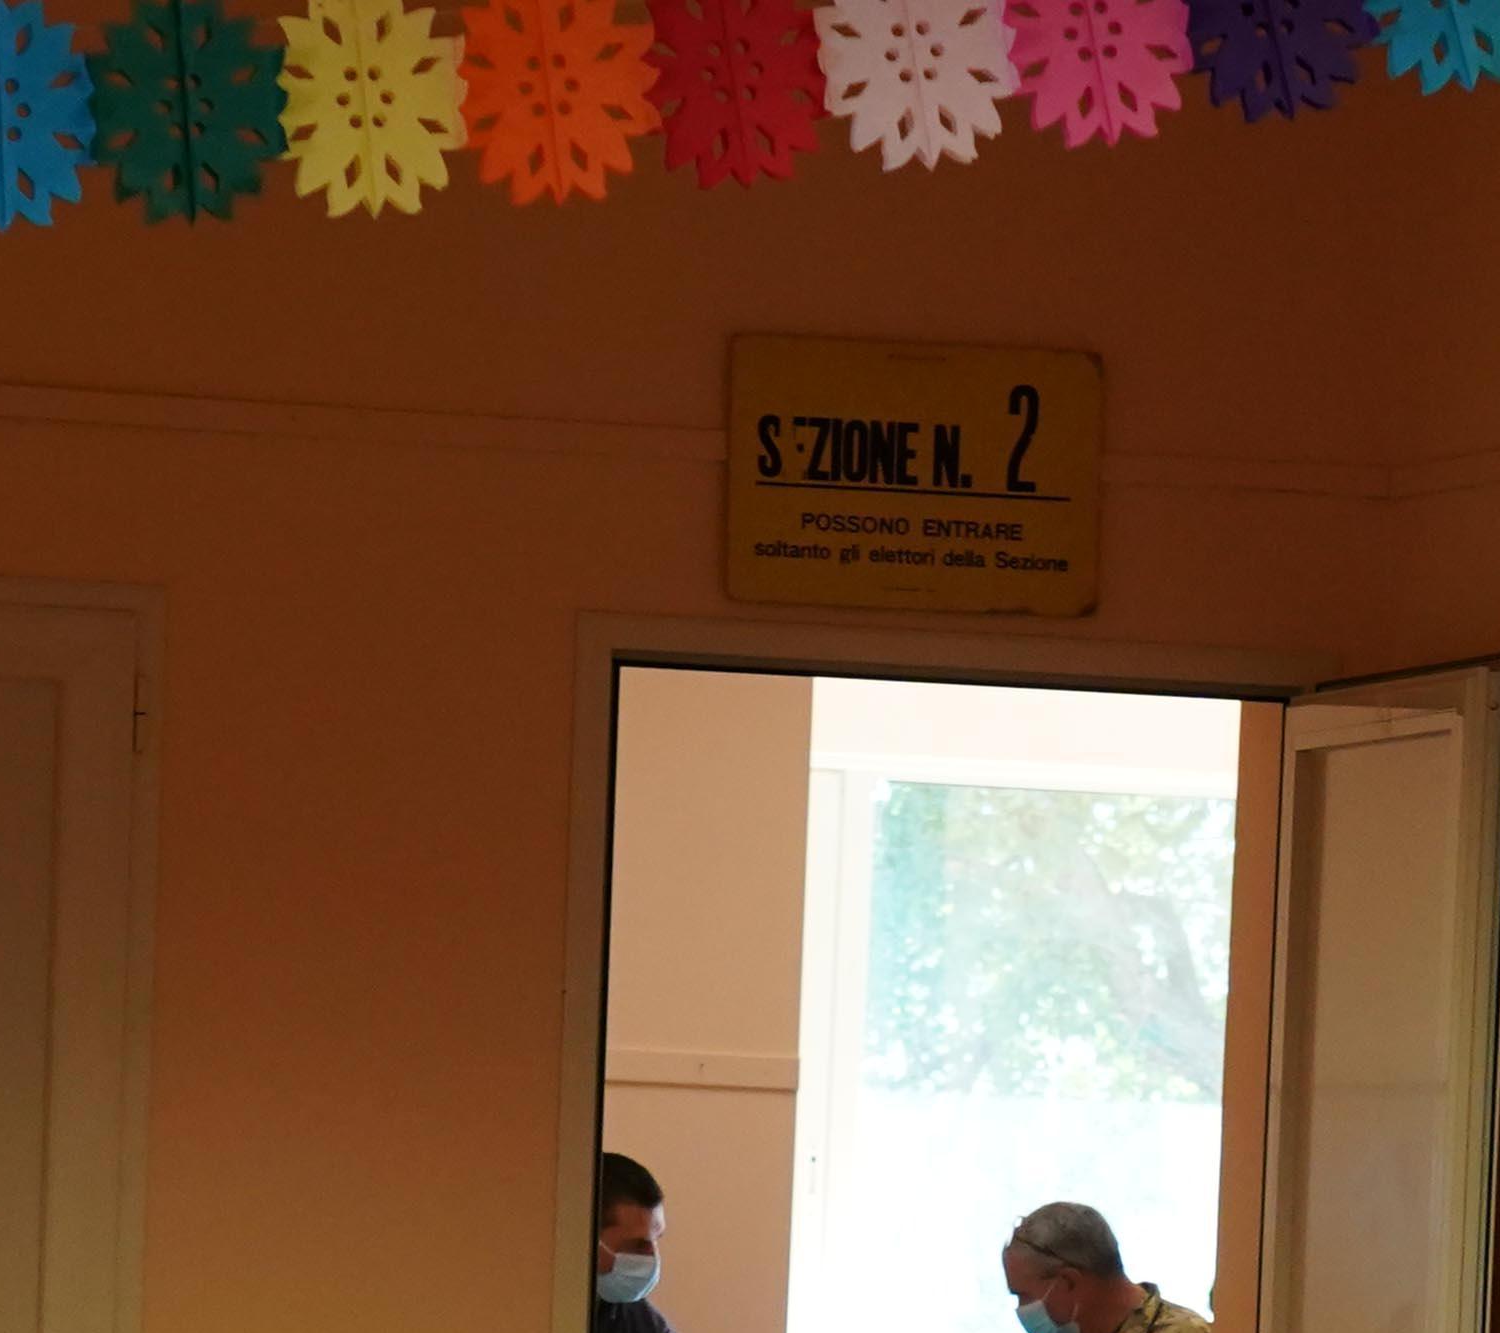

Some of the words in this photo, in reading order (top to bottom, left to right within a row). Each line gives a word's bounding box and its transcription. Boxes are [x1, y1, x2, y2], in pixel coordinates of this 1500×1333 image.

[932, 424, 973, 488] N.
[1006, 383, 1040, 493] 2
[801, 512, 910, 536] POSSONO
[923, 519, 1023, 541] ENTRARE
[755, 541, 831, 560] soltanto
[840, 545, 860, 564] gli
[869, 546, 935, 566] elettori
[942, 549, 985, 568] della
[995, 552, 1069, 572] Sezione
